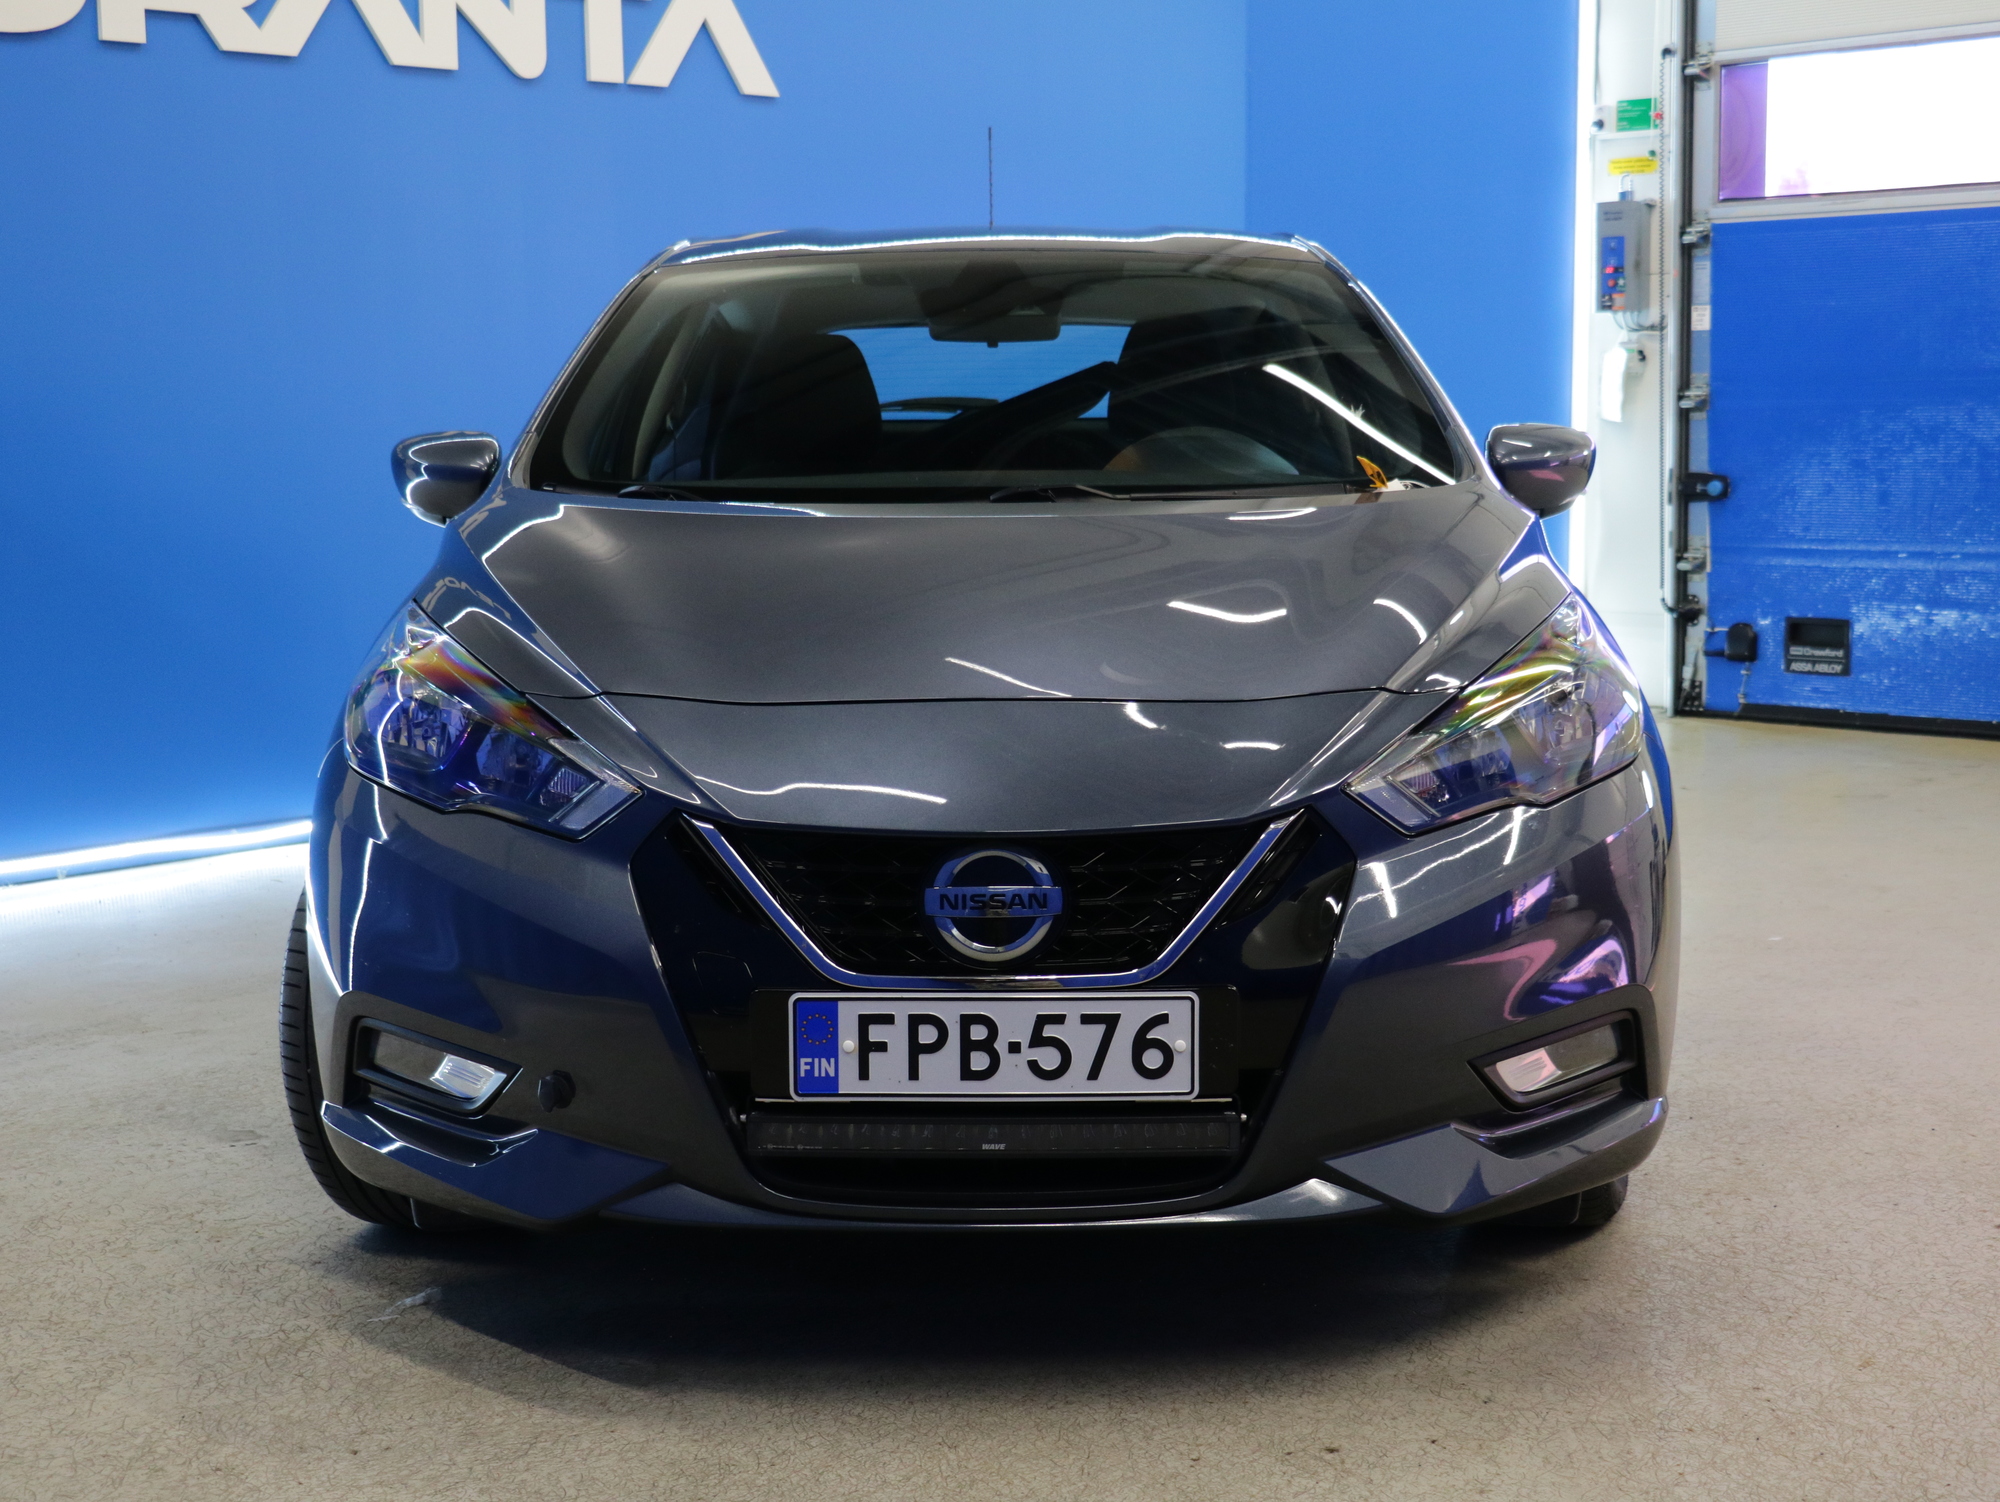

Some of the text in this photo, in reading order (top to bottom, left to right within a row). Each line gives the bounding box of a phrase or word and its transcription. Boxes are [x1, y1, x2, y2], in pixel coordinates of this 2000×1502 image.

[1790, 662, 1843, 673] ASSA ABLOY
[939, 893, 1048, 911] NISSAN
[800, 1057, 836, 1078] FIN
